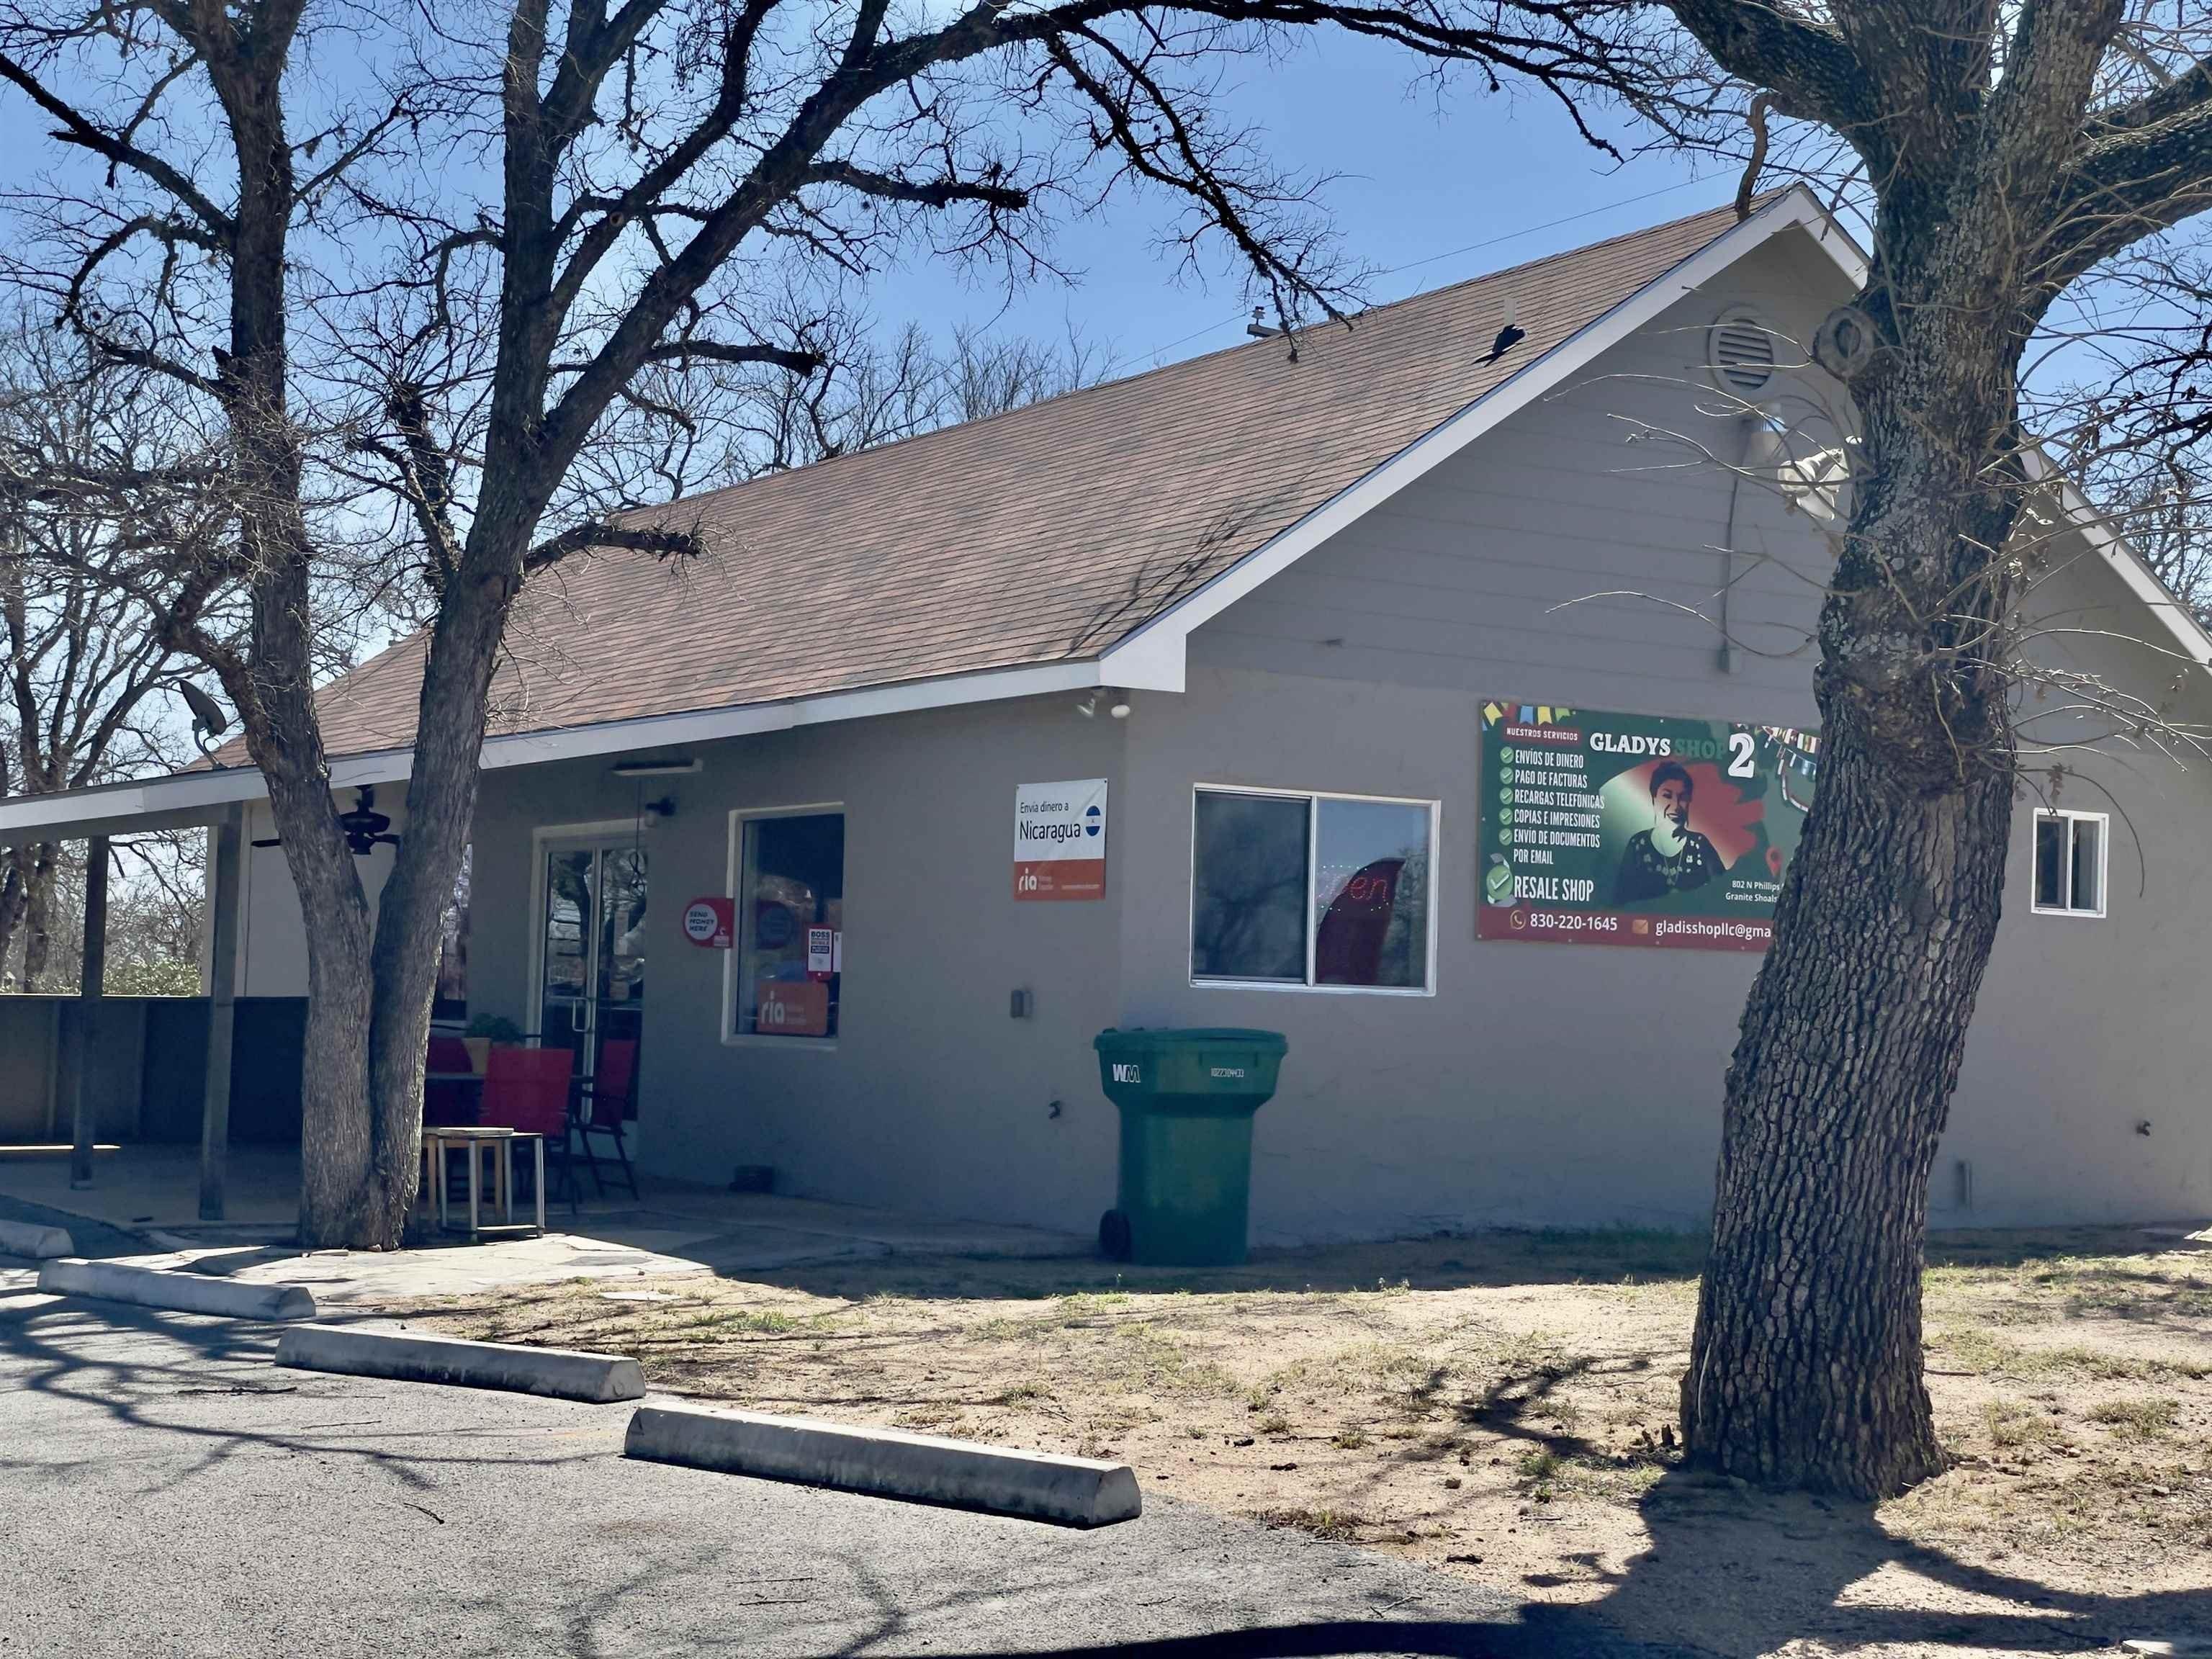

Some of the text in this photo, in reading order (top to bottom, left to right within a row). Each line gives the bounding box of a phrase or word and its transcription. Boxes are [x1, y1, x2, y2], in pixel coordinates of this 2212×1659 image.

[1506, 727, 1578, 740] NUESTROS SERVICIOS
[1515, 748, 1584, 768] ENVÍOS DE DINERO
[1589, 732, 1755, 778] GLADYS SHOP 2
[1514, 770, 1588, 788] PAGO DE FACTURAS
[1040, 801, 1063, 812] dinero
[1064, 802, 1069, 811] a
[1514, 789, 1606, 809] RECARGAS TELEFÓNICAS
[1514, 809, 1600, 828] COPIAS E IMPRESIONES
[1020, 820, 1082, 843] Nicaragua
[1514, 827, 1601, 848] ENVÍO DE DOCUMENTOS
[1514, 848, 1554, 865] POR EMAIL
[1018, 867, 1037, 891] ria
[1732, 880, 1745, 889] 802
[1754, 881, 1781, 893] Phillips
[1514, 876, 1594, 902] RESALE SHOP
[1725, 892, 1778, 904] Granite Shoals
[1529, 913, 1618, 931] 830-220-1645
[761, 991, 784, 1024] ria
[1112, 1064, 1141, 1083] WM
